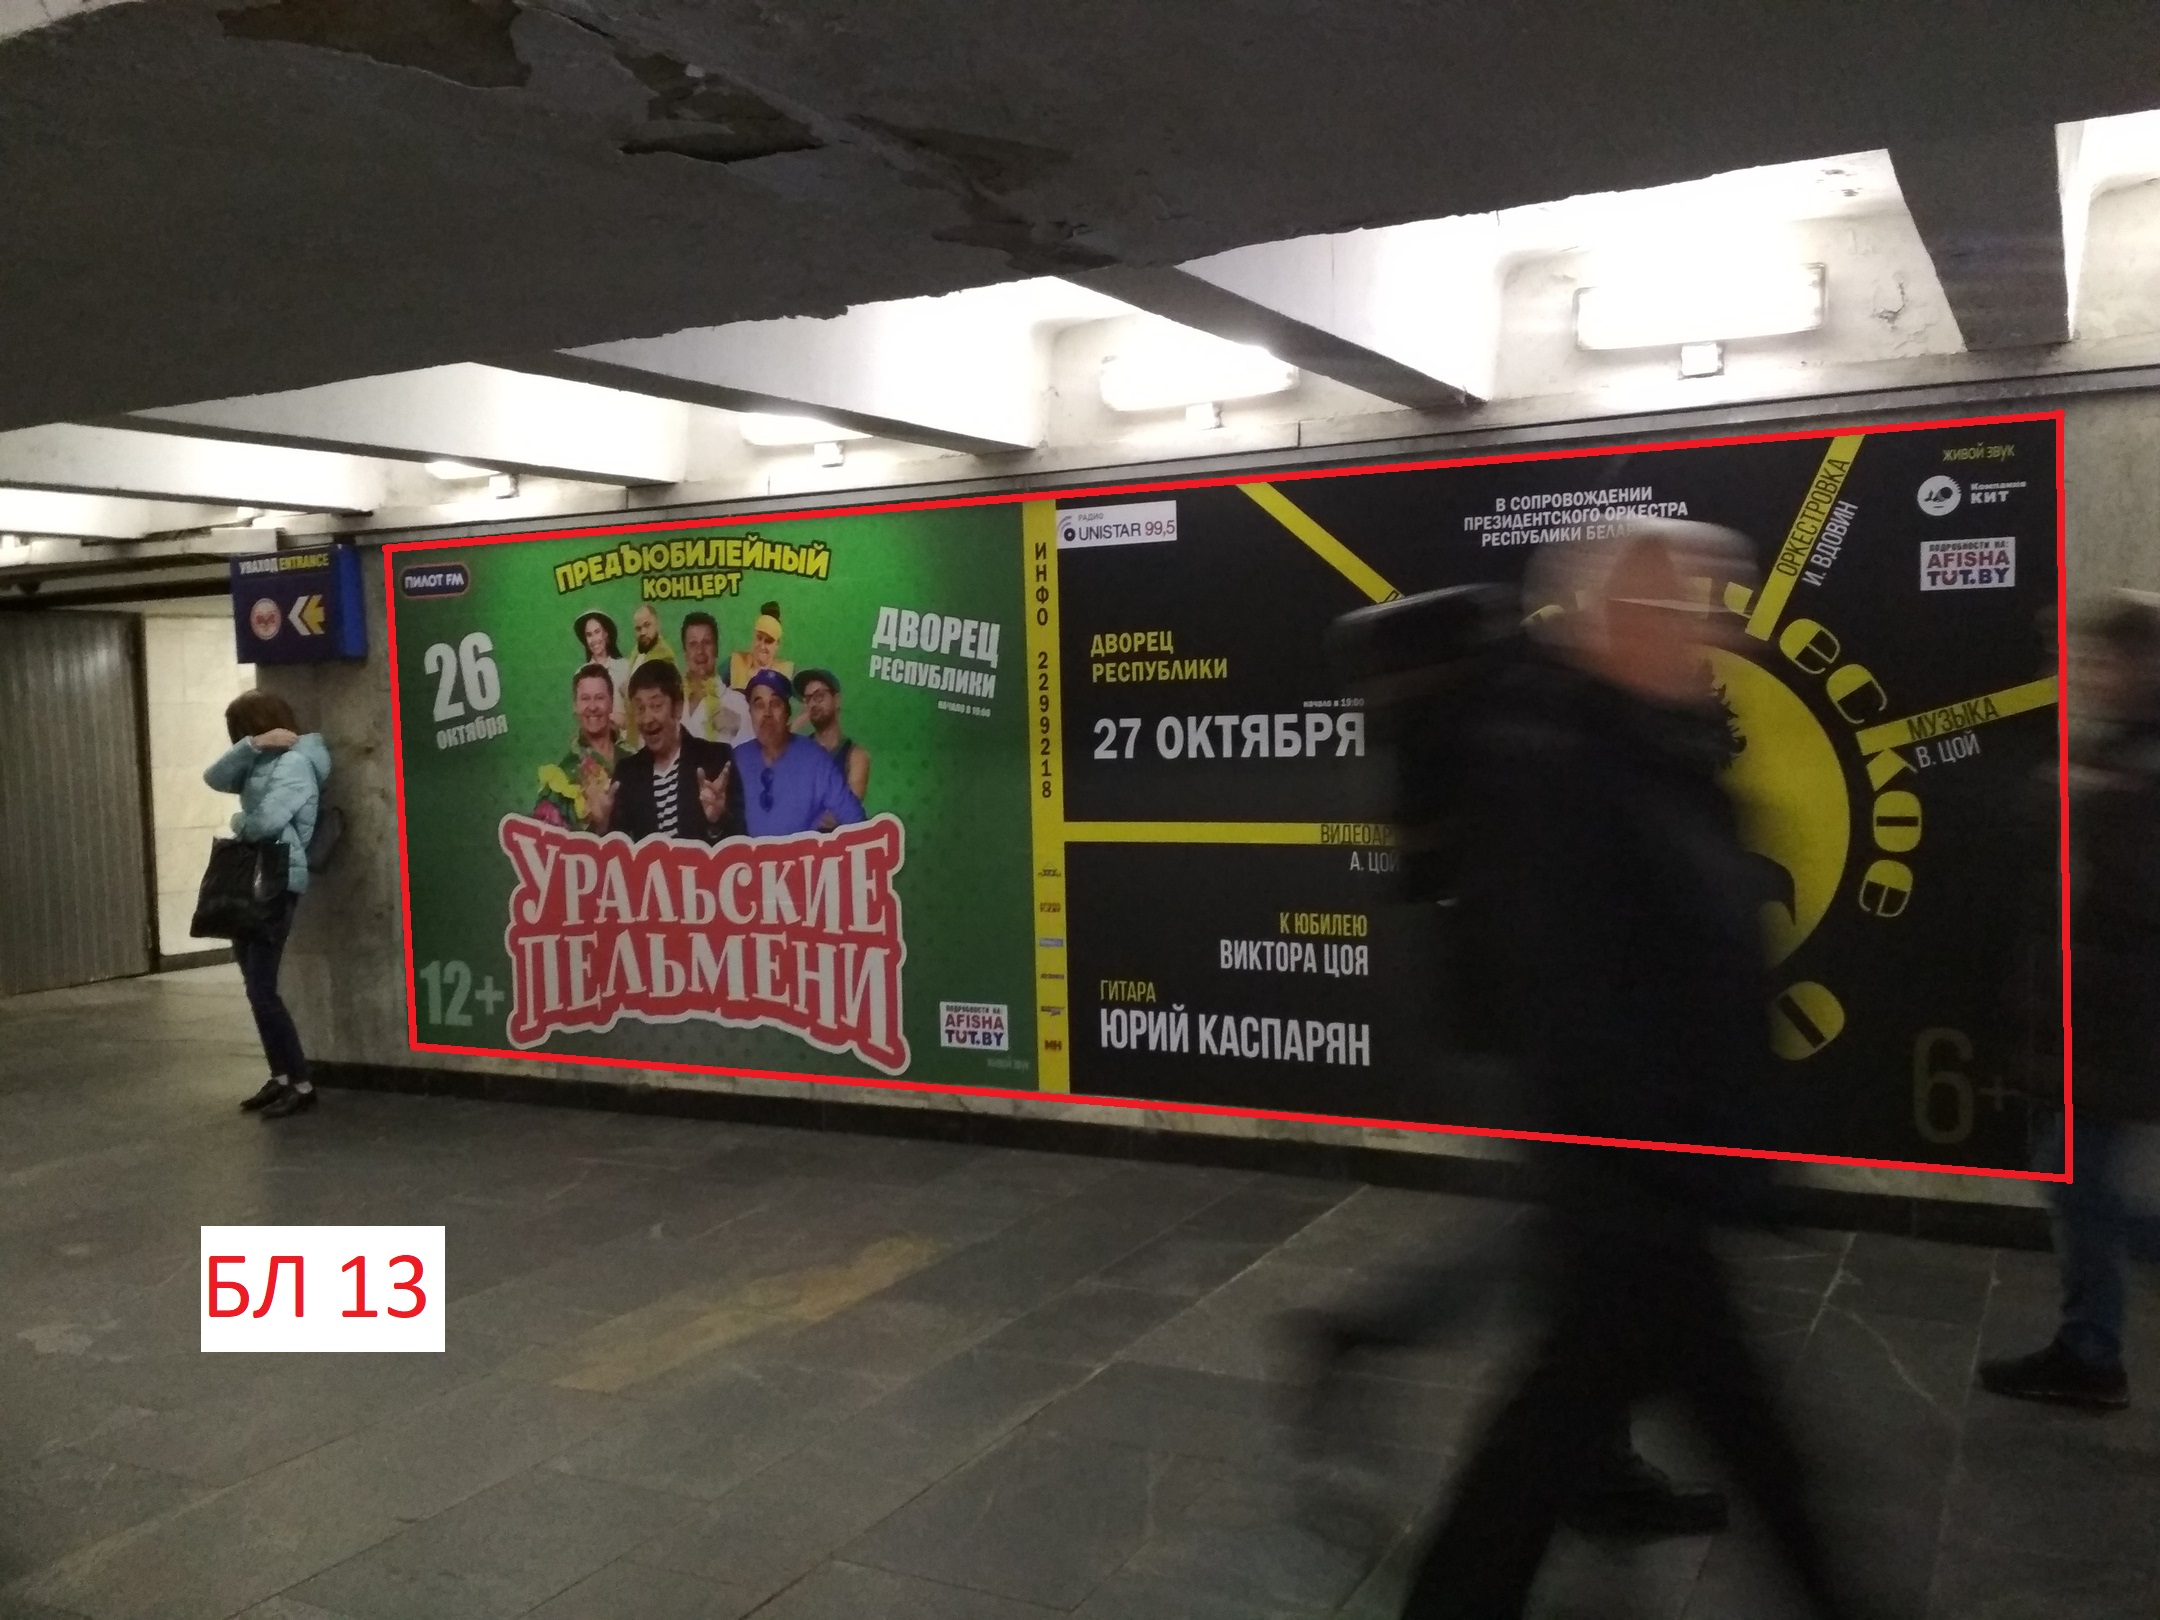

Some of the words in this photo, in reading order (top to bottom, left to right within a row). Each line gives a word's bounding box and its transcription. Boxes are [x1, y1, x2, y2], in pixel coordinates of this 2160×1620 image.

[1943, 442, 1984, 462] ЖИВОЙ
[1987, 444, 2015, 462] ЗВУК
[1495, 498, 1506, 512] В
[1510, 486, 1653, 511] СОПРОВОЖДЕНИИ
[1970, 490, 2009, 504] КИТ
[1078, 512, 1104, 521] РАДИО
[1078, 523, 1141, 541] UNISTAR
[1145, 519, 1176, 538] 99,5
[1464, 508, 1600, 531] ПРЕЗИДЕНТСКОГО
[1605, 501, 1688, 521] ОРКЕСТРА
[1776, 458, 1851, 577] ОРКЕСТРОВКА
[1481, 526, 1581, 547] РЕСПУБЛИКИ
[1810, 500, 1858, 569] ВДОВИН
[279, 553, 330, 570] ENTRANCE
[554, 533, 831, 593] ПРЕДЪЮБИЛЕЙНЫЙ
[1927, 550, 2010, 569] AFISHA
[404, 574, 443, 589] ПИЛОТ
[446, 572, 464, 587] FM
[643, 572, 741, 600] КОНЦЕРТ
[1035, 542, 1049, 626] ИНФО
[1927, 567, 2010, 586] TUT.BY
[872, 606, 1000, 669] ДВОРЕЦ
[1090, 630, 1174, 657] ДВОРЕЦ
[424, 631, 501, 723] 26
[869, 655, 996, 699] РЕСПУБЛИКИ
[1092, 658, 1228, 683] РЕСПУБЛИКИ
[436, 714, 508, 750] октября
[1037, 652, 1052, 798] 2299218
[1906, 696, 2000, 740] МУЗЫКА
[1093, 718, 1141, 760] 27
[1156, 712, 1365, 760] ОКТЯБРЯ
[1915, 746, 1937, 768] В.
[1938, 730, 1981, 763] ЦОЙ
[1320, 824, 1395, 845] ВИДЕОАР
[513, 832, 892, 936] УРАЛЬСКИЕ
[1279, 912, 1290, 934] К
[1294, 912, 1368, 937] ЮБИЛЕЮ
[1219, 939, 1317, 974] ВИКТОРА
[1324, 943, 1369, 978] ЦОЯ
[418, 959, 505, 1027] 12+
[518, 928, 894, 1055] ПЕЛЬМЕНИ
[1100, 980, 1156, 1003] ГИТАРА
[945, 1013, 1004, 1030] AFISHA
[1100, 1003, 1189, 1053] ЮРИЙ
[1198, 1013, 1370, 1066] КАСПАРЯН
[945, 1029, 1004, 1046] TUT.BY
[1912, 1027, 2030, 1145] 6+
